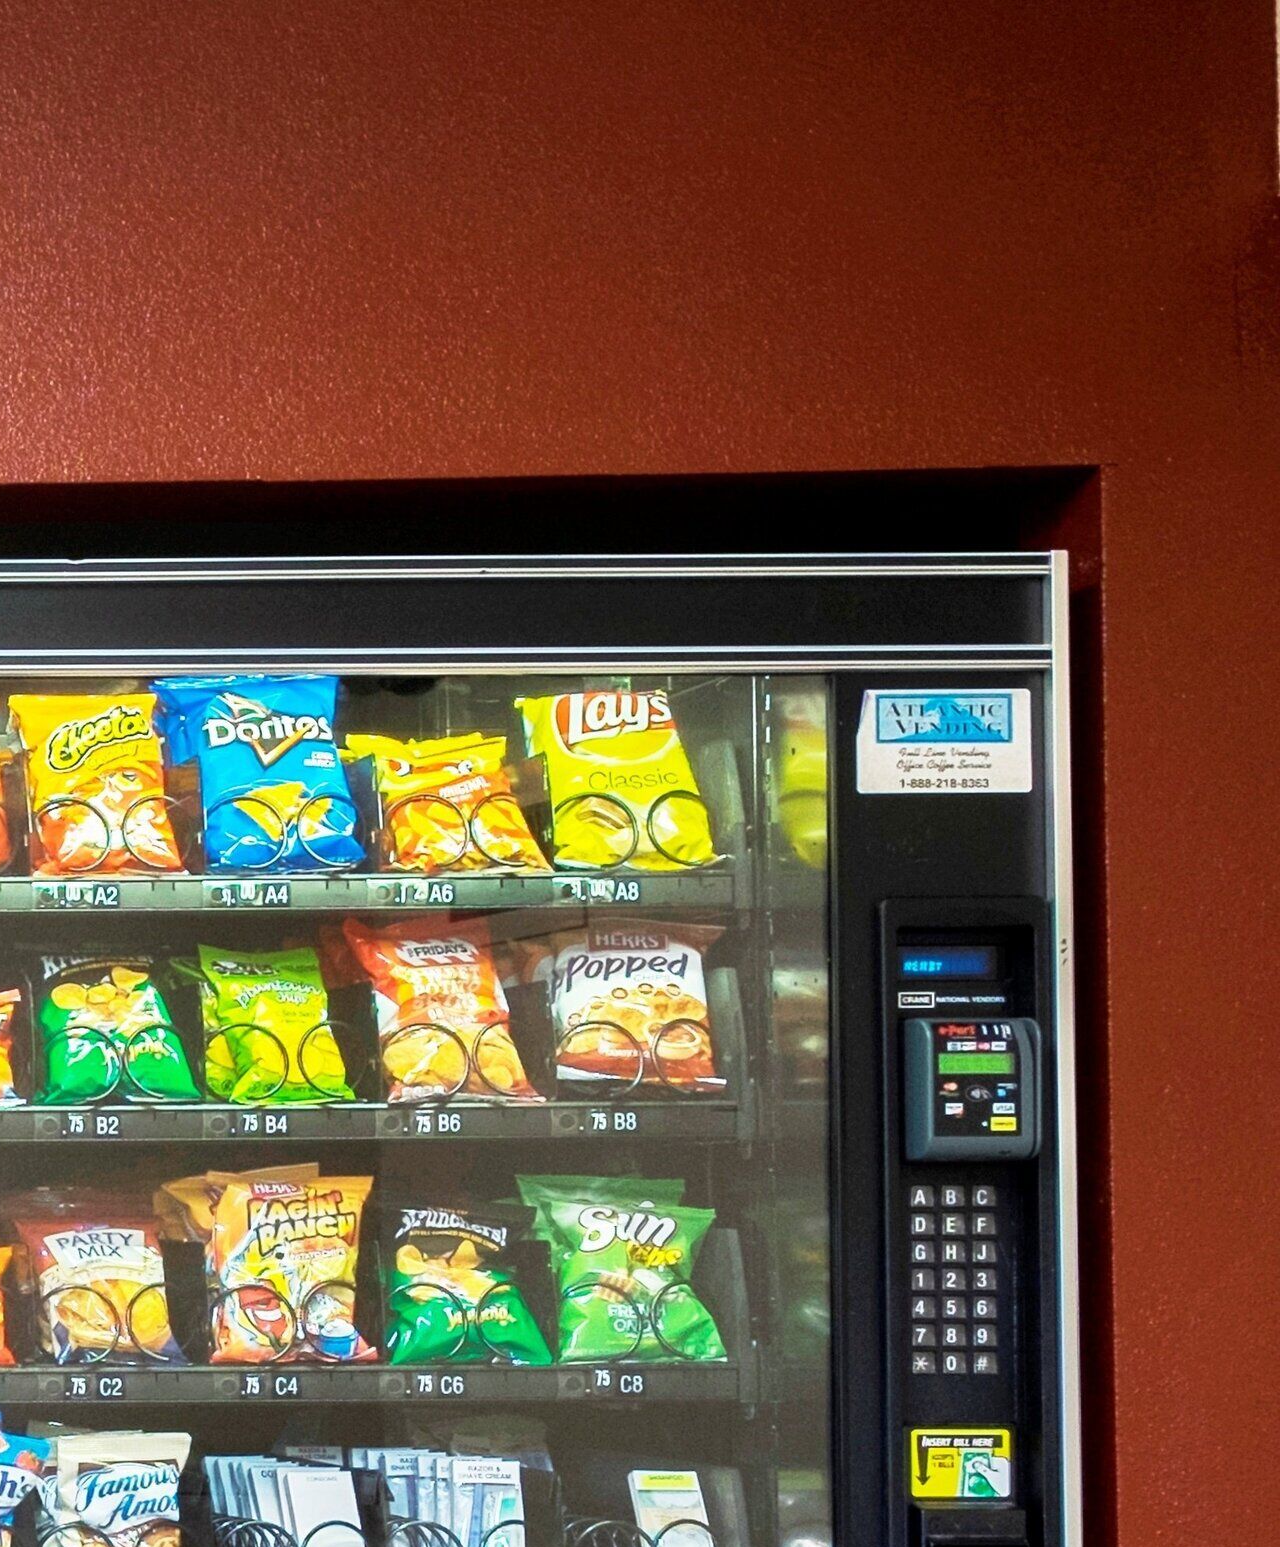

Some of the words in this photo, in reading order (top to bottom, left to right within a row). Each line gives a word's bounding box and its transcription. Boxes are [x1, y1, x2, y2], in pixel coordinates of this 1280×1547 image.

[887, 702, 1003, 718] ATLANTIC
[202, 716, 333, 749] Doritos
[895, 719, 1003, 736] VENDING
[951, 746, 990, 758] Vending
[896, 759, 923, 772] Office
[926, 759, 954, 772] Coffee
[957, 759, 992, 770] Service
[588, 769, 679, 791] Classic
[899, 778, 989, 789] 1-888-218-8363
[94, 886, 119, 906] A2
[264, 885, 289, 904] A4
[428, 884, 454, 903] A6
[615, 879, 639, 901] A8
[413, 942, 468, 957] FRIDAYS
[566, 952, 689, 993] Popped
[901, 996, 931, 1004] CRANE
[96, 1116, 119, 1135] B2
[265, 1115, 288, 1134] B4
[438, 1114, 461, 1133] B6
[614, 1112, 637, 1131] B8
[914, 1189, 926, 1205] A
[946, 1189, 956, 1205] B
[976, 1189, 988, 1205] C
[578, 1206, 678, 1253] Sun
[914, 1217, 926, 1233] D
[946, 1217, 956, 1233] E
[976, 1217, 988, 1233] F
[56, 1231, 134, 1251] PARTY
[257, 1211, 357, 1257] RANCH
[77, 1244, 124, 1259] MIX
[914, 1245, 926, 1260] G
[946, 1245, 956, 1260] H
[976, 1245, 988, 1260] J
[914, 1273, 926, 1288] 1
[946, 1273, 956, 1288] 2
[976, 1273, 988, 1288] 3
[914, 1301, 926, 1315] 4
[946, 1301, 956, 1315] 5
[976, 1301, 988, 1315] 6
[914, 1328, 926, 1343] 7
[946, 1328, 956, 1343] 8
[976, 1328, 988, 1343] 9
[946, 1356, 956, 1371] 0
[99, 1378, 123, 1397] C2
[275, 1376, 298, 1395] C4
[440, 1375, 465, 1394] C6
[620, 1375, 644, 1393] C8
[921, 1435, 951, 1448] INSERT
[953, 1437, 970, 1448] BILL
[972, 1437, 994, 1448] HERE
[76, 1464, 181, 1511] Famous
[102, 1491, 180, 1528] Amos
